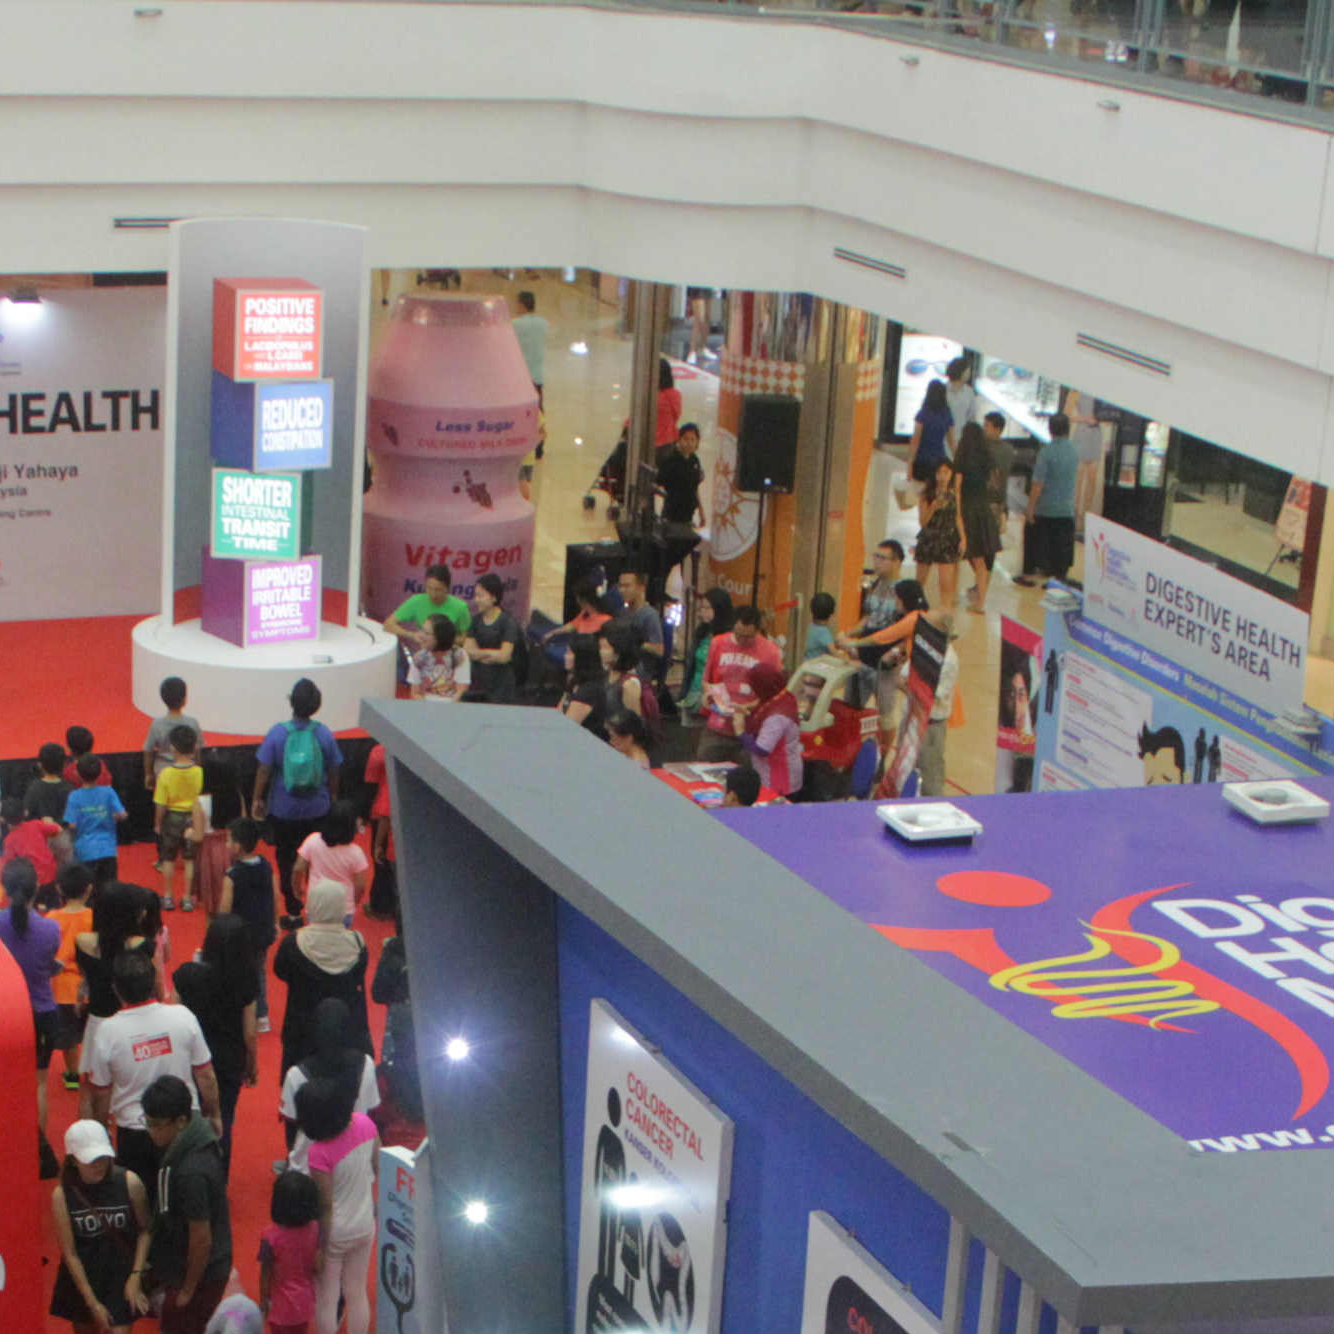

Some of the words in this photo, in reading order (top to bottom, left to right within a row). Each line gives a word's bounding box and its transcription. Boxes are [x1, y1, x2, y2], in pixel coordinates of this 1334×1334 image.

[245, 298, 316, 315] POSITIVE
[244, 317, 316, 334] FINDINGS
[262, 397, 324, 429] REDUCED
[477, 420, 515, 433] Sugar
[14, 463, 79, 481] Yahaya
[222, 476, 293, 508] SHORTER
[221, 505, 290, 521] INTESTINAL
[222, 519, 292, 540] TRANSIT
[231, 535, 278, 551] TIME
[405, 543, 523, 575] Vitagen
[252, 564, 313, 590] IMPROVED
[252, 586, 311, 606] IRRITABLE
[260, 602, 303, 620] BOWEL
[1145, 572, 1232, 633] DIGESTIVE
[1236, 612, 1302, 669] HEALTH
[1143, 599, 1221, 656] EXPERT'S
[1225, 648, 1271, 682] AREA
[627, 1071, 705, 1161] COLORECTAL
[626, 1098, 675, 1160] CANCER
